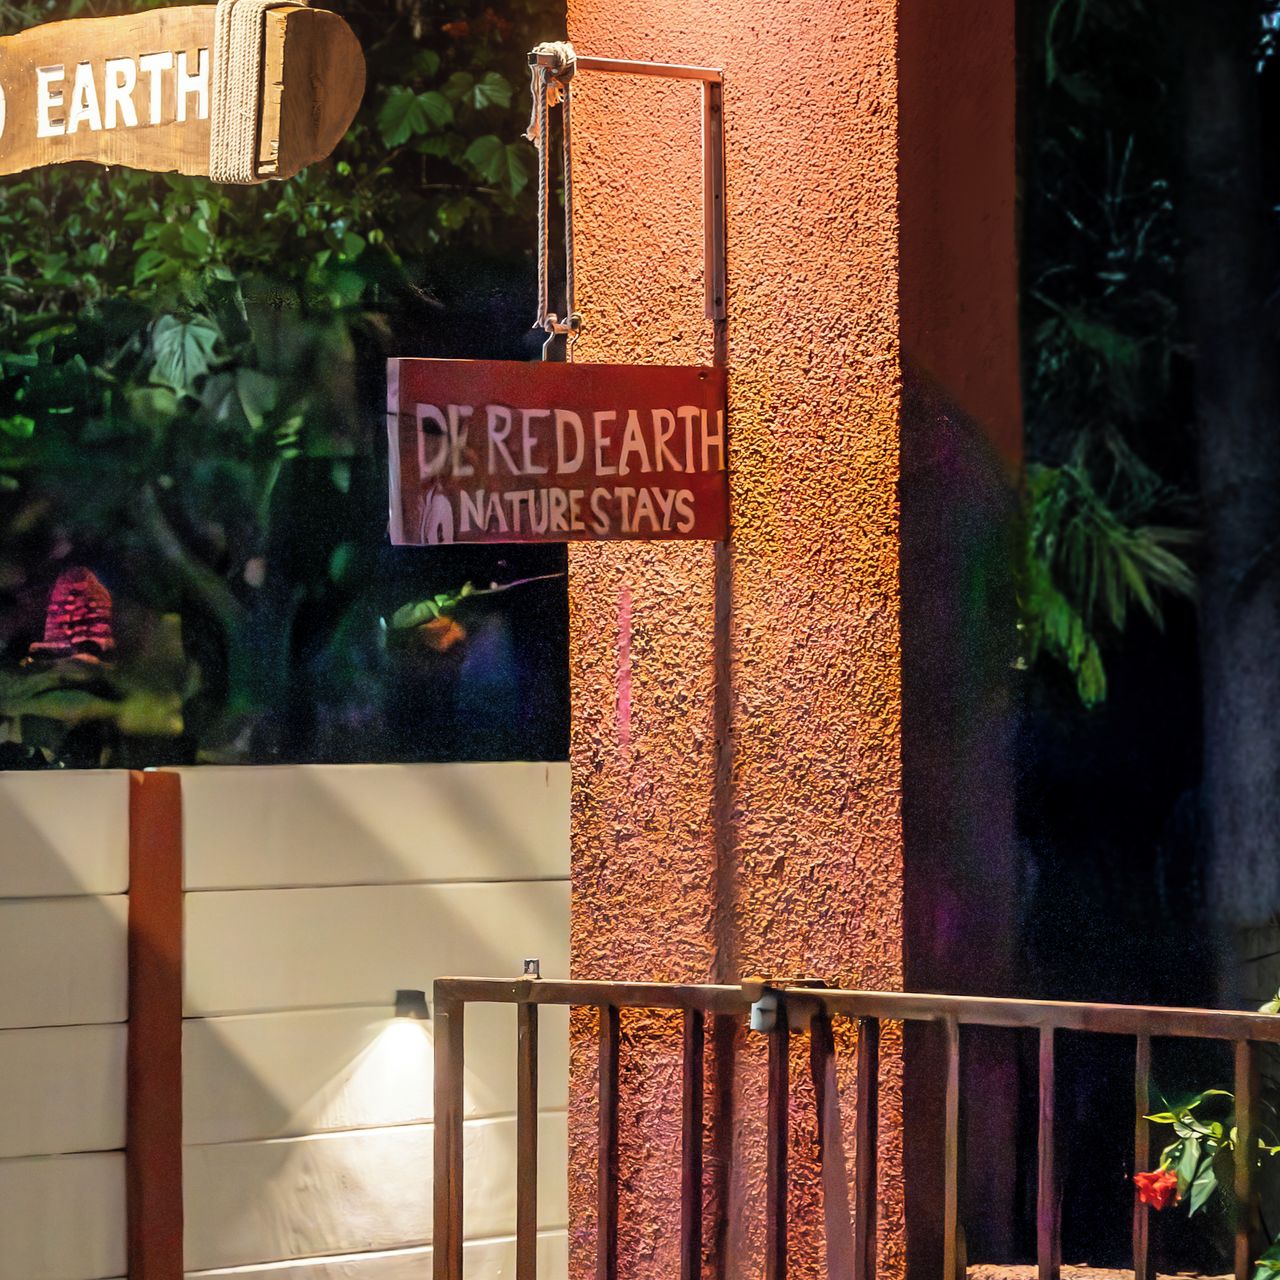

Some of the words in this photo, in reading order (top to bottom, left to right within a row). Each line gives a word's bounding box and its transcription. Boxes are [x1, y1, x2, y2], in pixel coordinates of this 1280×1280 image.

[36, 47, 210, 138] EARTH
[416, 402, 474, 479] DE
[486, 403, 585, 476] RED
[594, 405, 726, 476] EARTH
[460, 488, 585, 534] NATURE
[590, 486, 696, 535] STAYS
